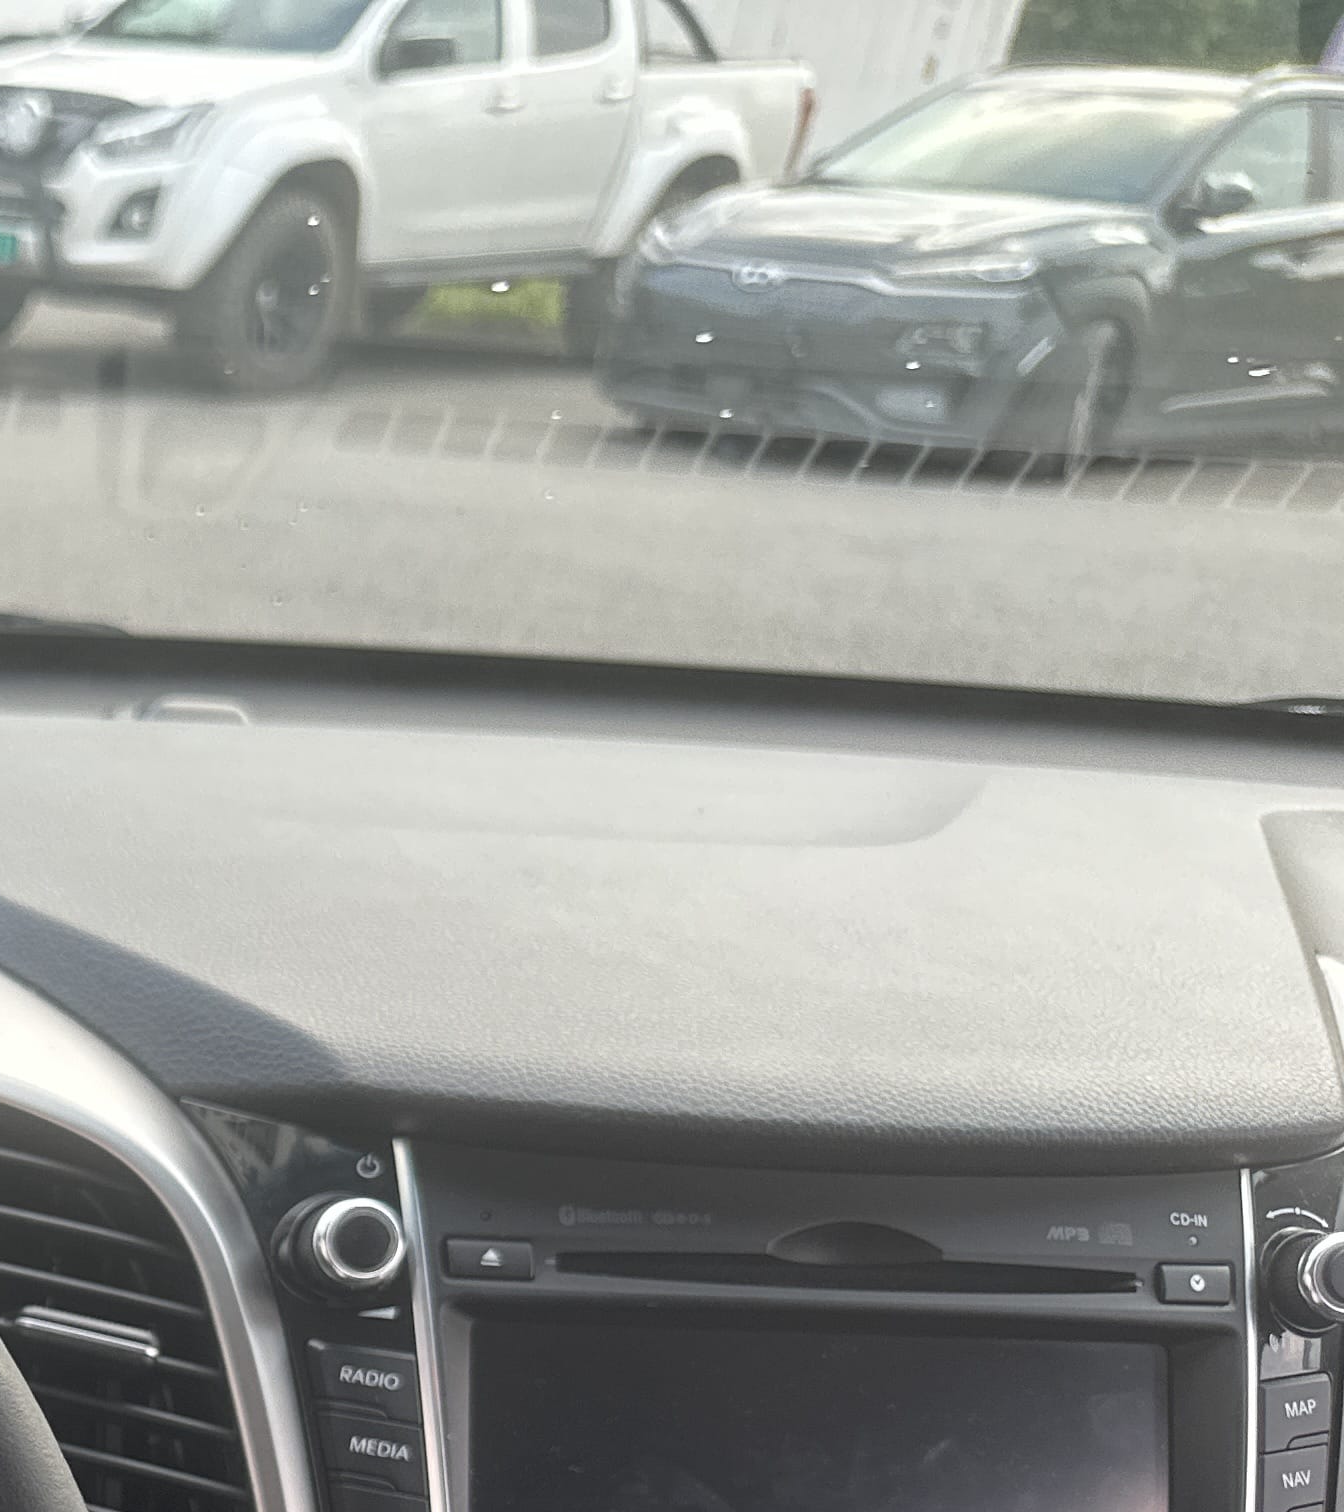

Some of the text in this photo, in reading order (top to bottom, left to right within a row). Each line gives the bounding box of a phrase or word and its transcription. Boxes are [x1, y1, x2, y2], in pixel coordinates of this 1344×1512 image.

[1169, 1211, 1209, 1228] CD-IN
[1046, 1226, 1090, 1242] MP3
[338, 1365, 401, 1392] RADIO
[1284, 1398, 1318, 1420] MAP
[348, 1436, 410, 1462] MEDIA
[1282, 1469, 1312, 1491] NAV
